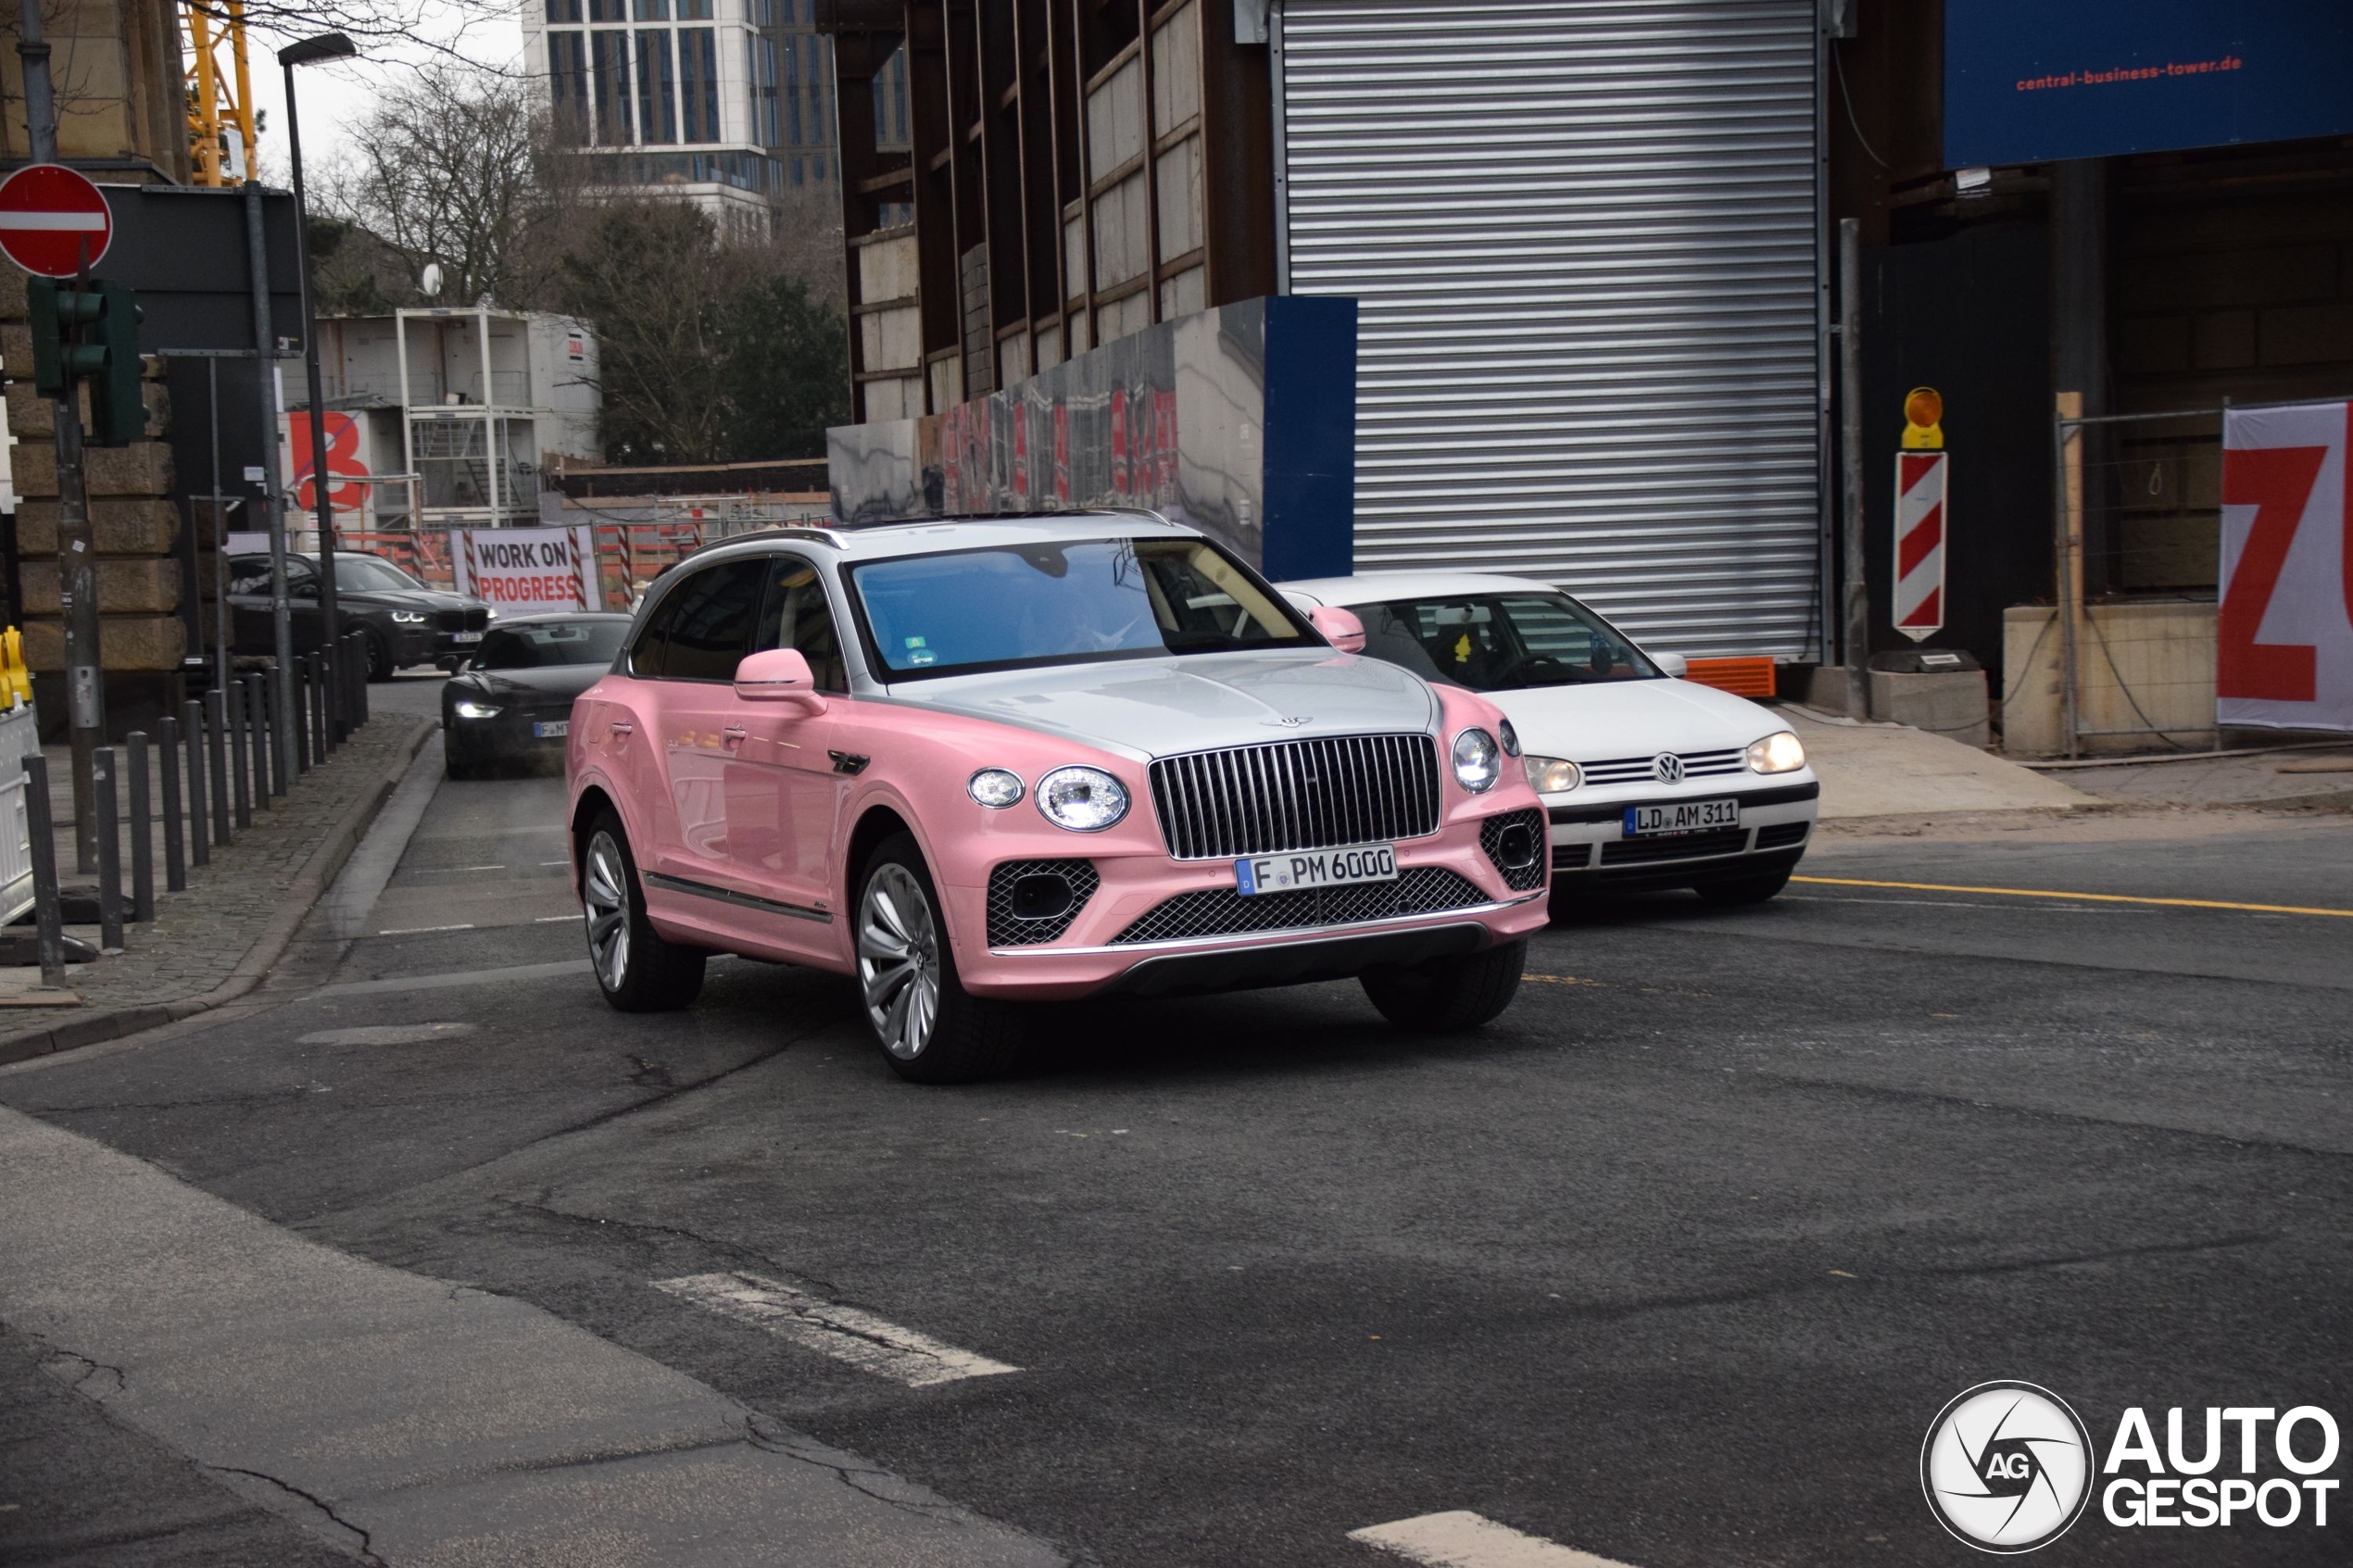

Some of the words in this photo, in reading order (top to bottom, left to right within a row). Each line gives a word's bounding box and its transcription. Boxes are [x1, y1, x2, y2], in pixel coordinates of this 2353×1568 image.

[2016, 56, 2243, 91] central-business-tower.de
[478, 543, 538, 569] WORK
[540, 542, 568, 567] ON
[478, 575, 578, 602] PROGRESS
[541, 724, 549, 736] F
[1637, 809, 1663, 830] LD
[1675, 805, 1699, 827] AM
[1703, 802, 1736, 824] 311
[1243, 880, 1250, 889] D
[1253, 860, 1271, 889] F
[1290, 855, 1327, 884] PM
[1331, 849, 1393, 880] 6000
